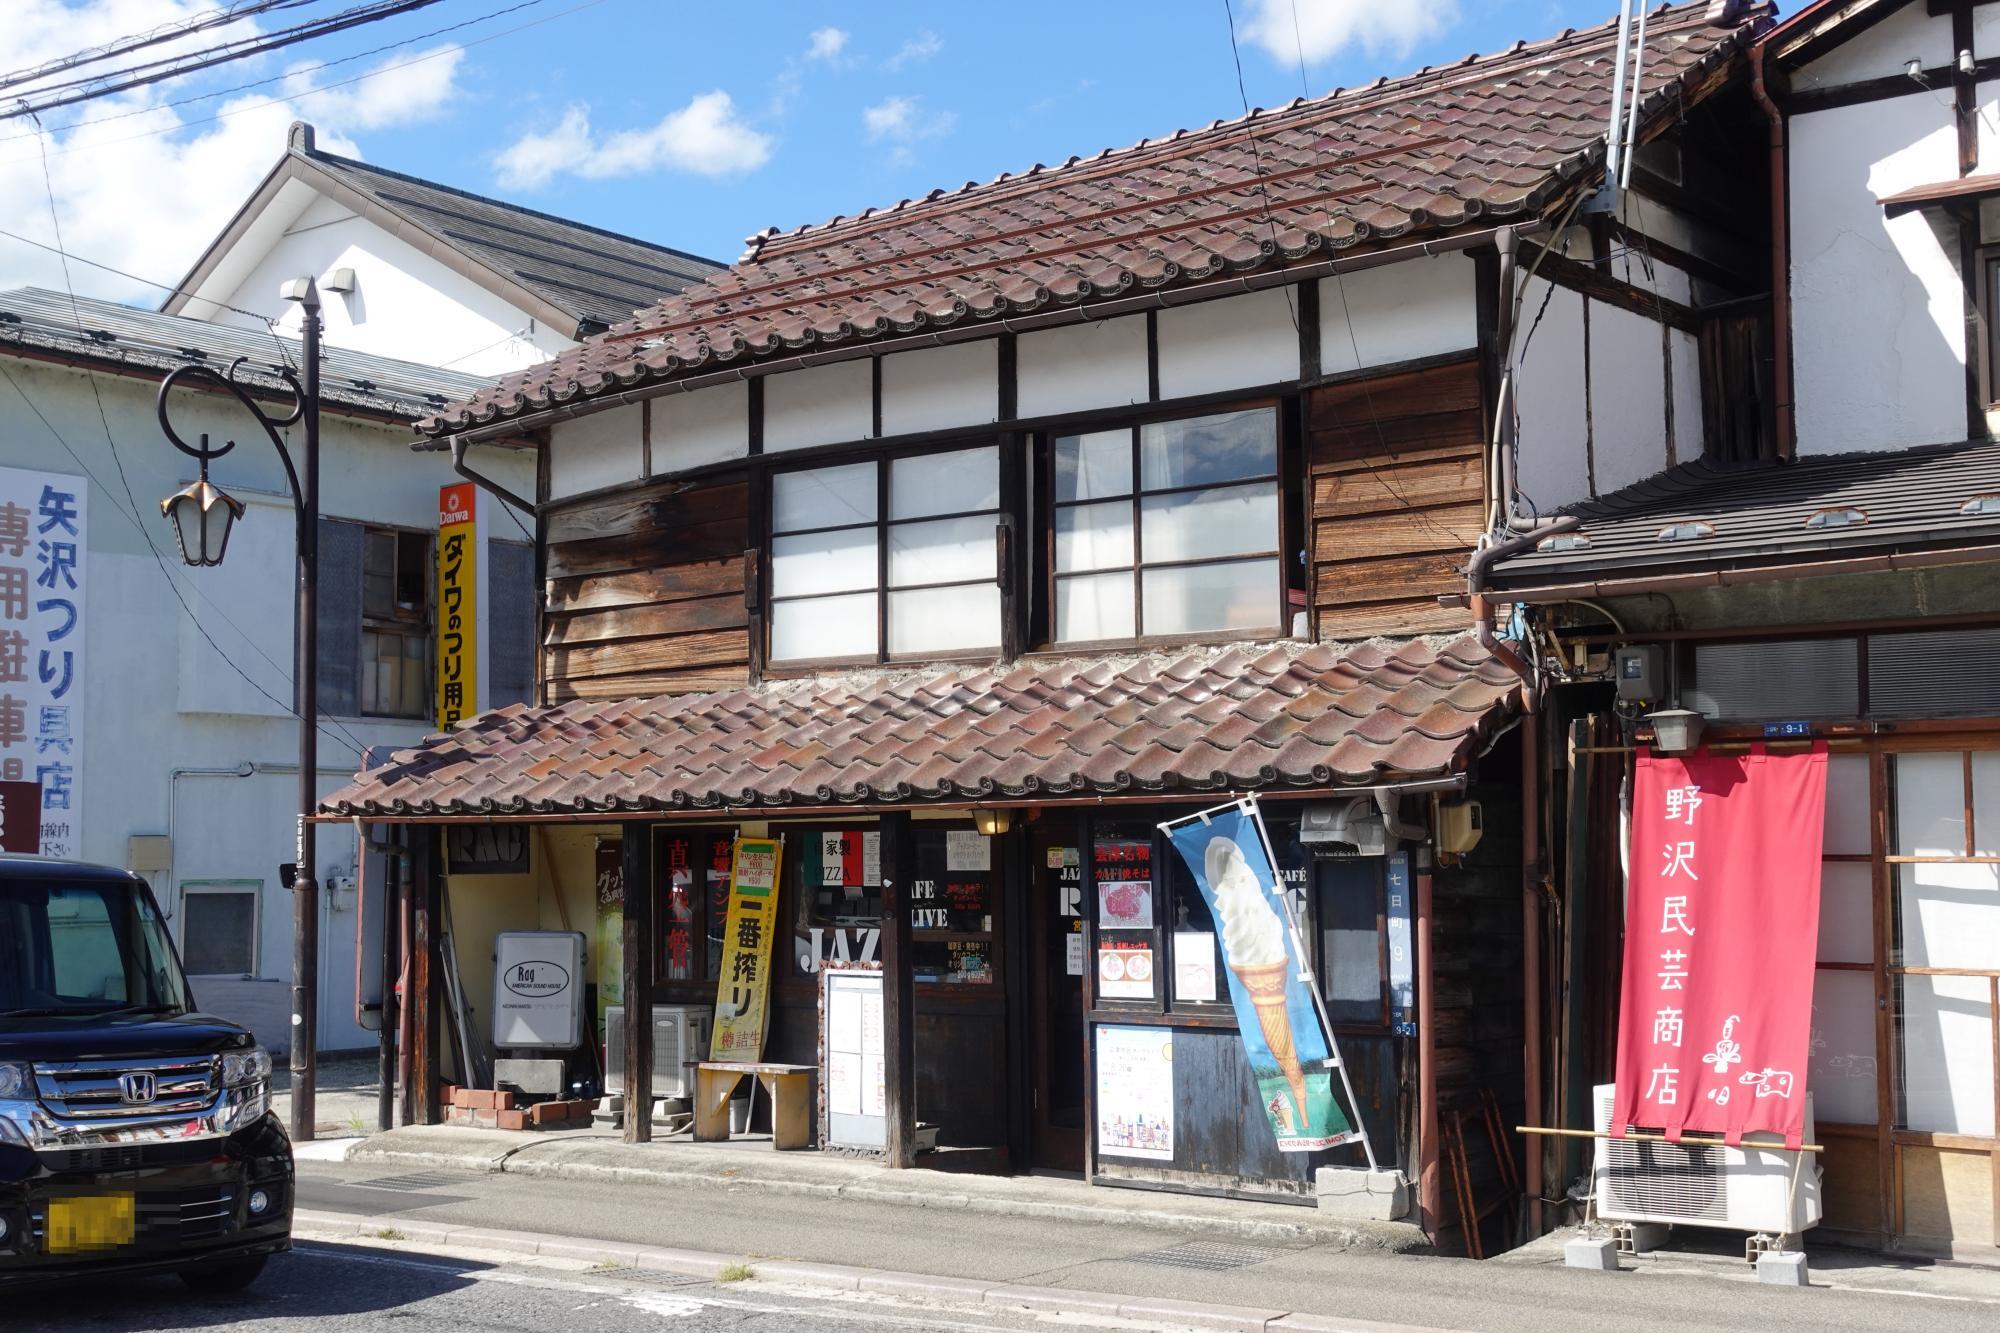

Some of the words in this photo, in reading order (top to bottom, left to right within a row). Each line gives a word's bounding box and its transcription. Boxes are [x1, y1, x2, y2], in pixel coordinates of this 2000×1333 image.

[440, 511, 468, 526] Daiwa
[0, 501, 31, 781] 専用駐車
[36, 485, 79, 810] 矢沢つり具店
[1786, 724, 1803, 733] 9-1
[518, 966, 535, 983] Rag
[733, 900, 763, 1018] 一番搾り
[1645, 785, 1702, 1106] 野沢民芸商店
[1395, 1024, 1412, 1036] 9-2
